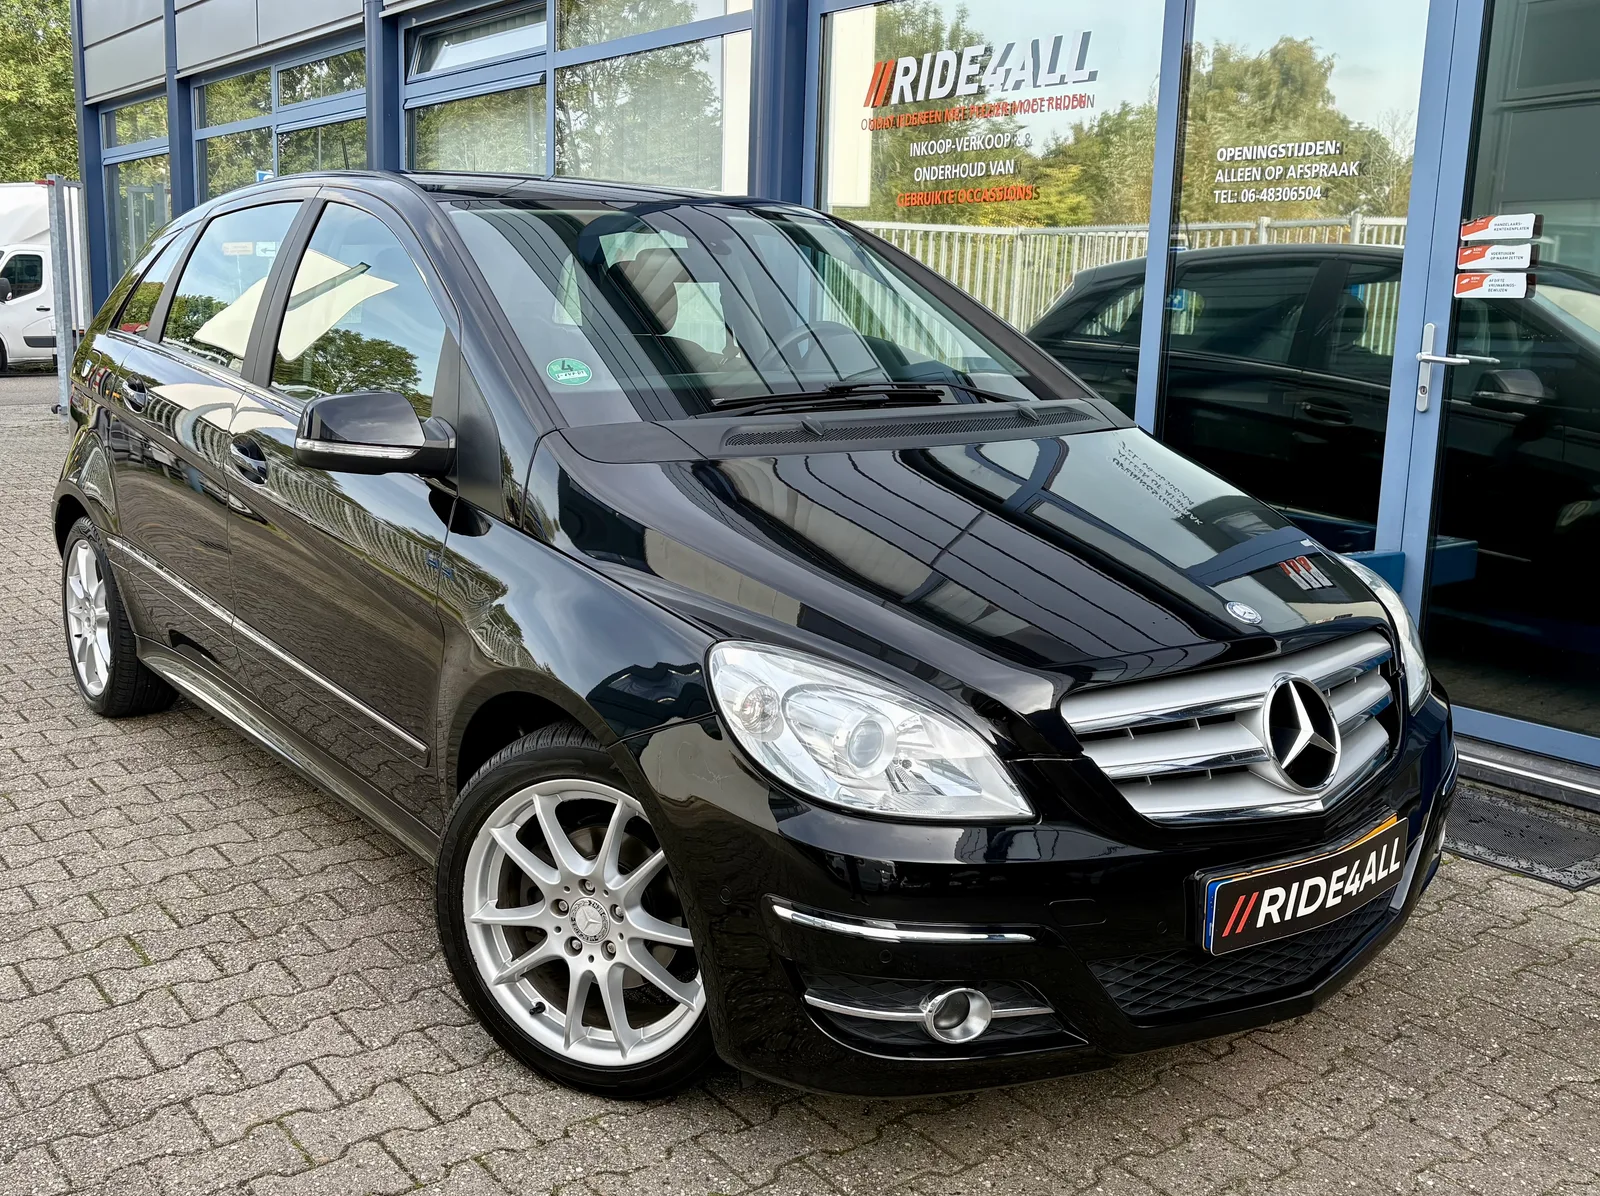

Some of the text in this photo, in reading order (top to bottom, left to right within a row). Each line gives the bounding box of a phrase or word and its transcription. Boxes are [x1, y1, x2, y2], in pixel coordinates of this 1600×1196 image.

[910, 132, 1011, 157] INKOOP-VERKOOP
[1216, 140, 1341, 162] OPENINGSTIJDEN:
[914, 159, 1015, 182] ONDERHOUD VAN
[1215, 161, 1360, 183] ALLEEN OP AFSPRAAK
[896, 185, 1034, 207] GEBRUIKTE OCCASSIONS
[1214, 186, 1322, 203] TEL: 06-48306504
[561, 359, 574, 372] 4
